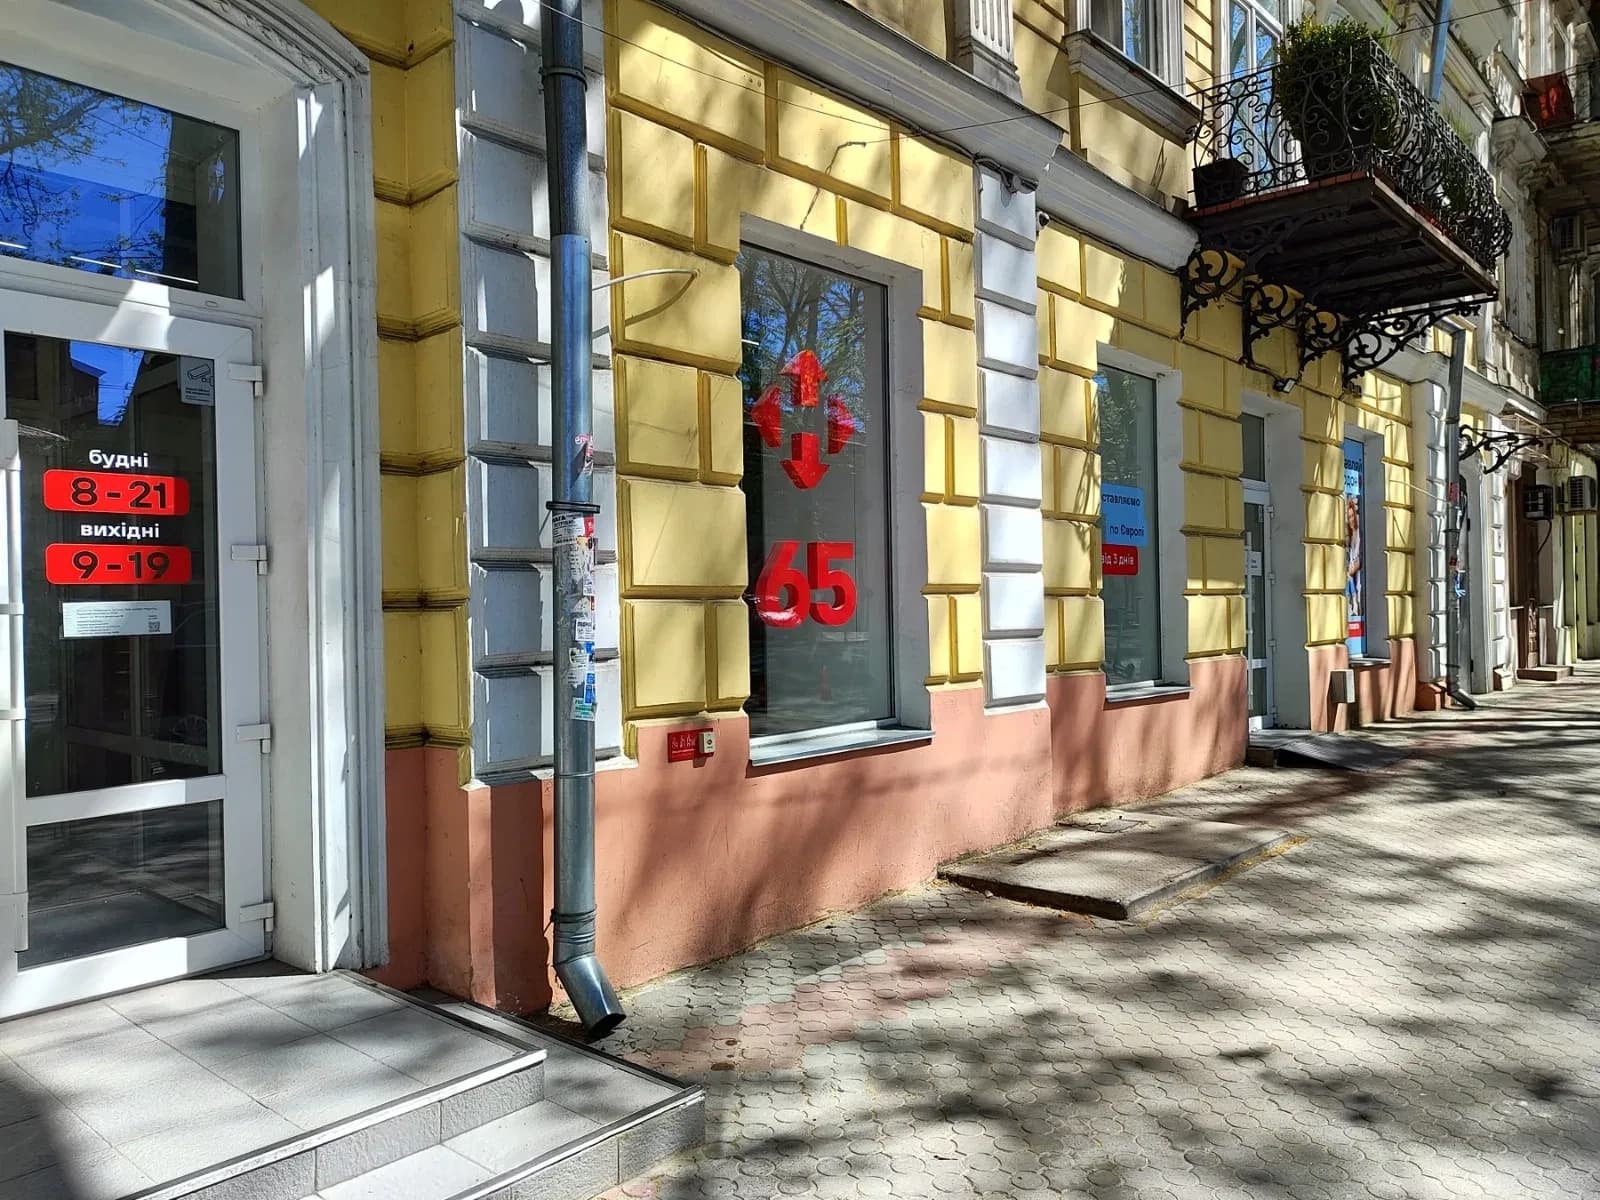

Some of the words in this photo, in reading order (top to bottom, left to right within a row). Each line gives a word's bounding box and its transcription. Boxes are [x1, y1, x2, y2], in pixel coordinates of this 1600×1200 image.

[88, 449, 149, 469] будні
[80, 521, 160, 540] вихідні
[1109, 525, 1119, 536] по
[1120, 524, 1145, 539] Європі
[1118, 554, 1135, 566] днів
[755, 540, 858, 629] 65
